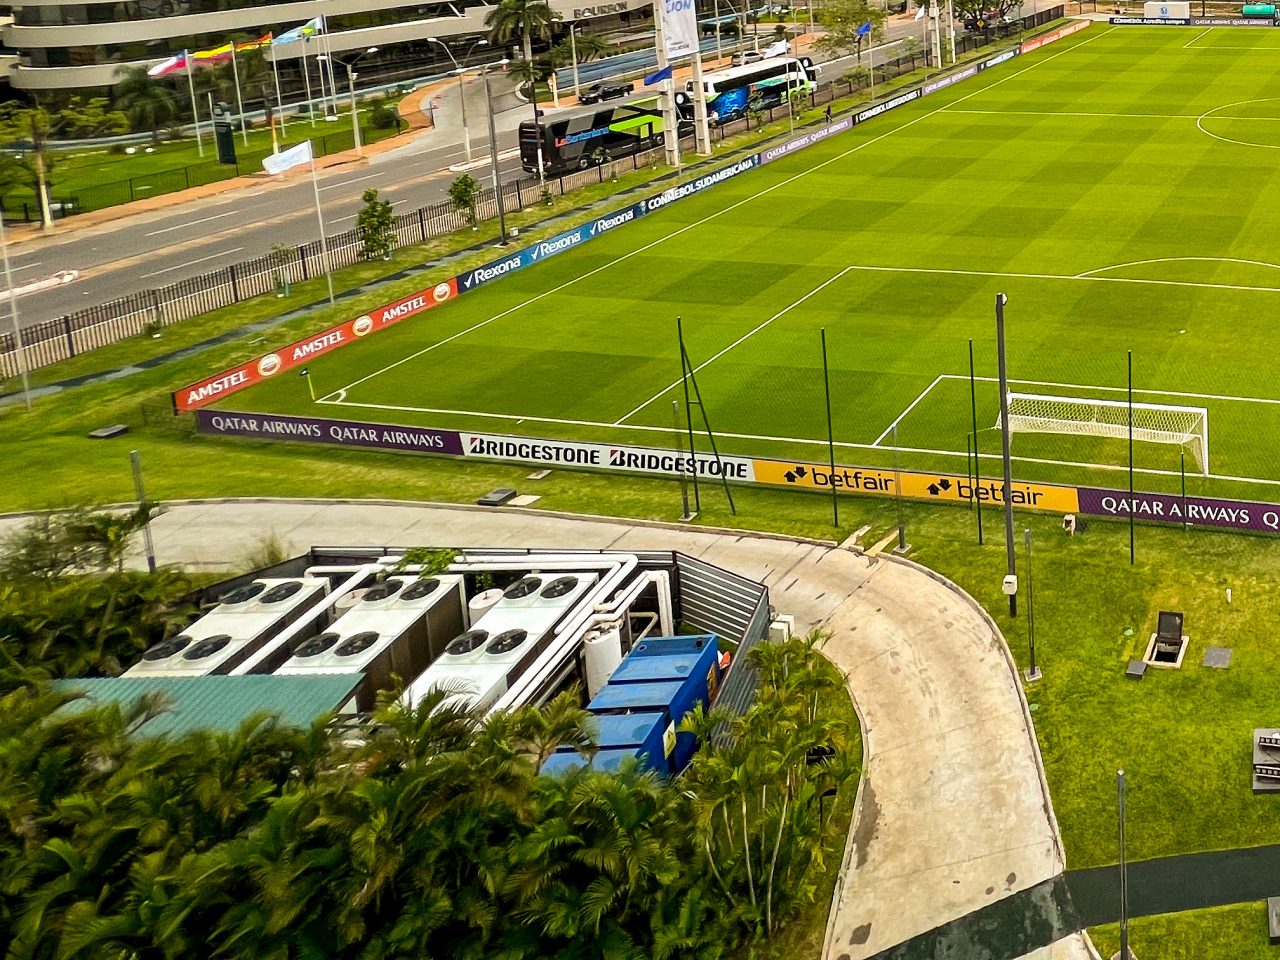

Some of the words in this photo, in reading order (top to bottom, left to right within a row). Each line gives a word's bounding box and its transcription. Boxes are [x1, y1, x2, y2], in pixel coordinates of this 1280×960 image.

[574, 1, 628, 19] BOURBON
[766, 144, 787, 160] QATAR
[810, 126, 829, 142] QATAR
[648, 184, 697, 211] CONMEBOL
[694, 159, 754, 192] SUDAMERICANA
[595, 208, 634, 233] Rexona
[539, 230, 581, 256] Rexona
[474, 254, 522, 284] Rexona
[381, 295, 426, 323] AMSTEL
[292, 330, 345, 361] AMSTEL
[187, 369, 249, 405] AMSTEL
[211, 416, 259, 432] QATAR
[262, 420, 321, 437] AIRWAYS
[329, 426, 378, 442] QATAR
[382, 431, 444, 448] AIRWAYS
[470, 437, 600, 465] BRIDGESTONE
[609, 449, 748, 478] BRIDGESTONE
[812, 467, 894, 492] betfair
[1101, 496, 1164, 517] QATAR
[1168, 503, 1250, 524] AIRWAYS
